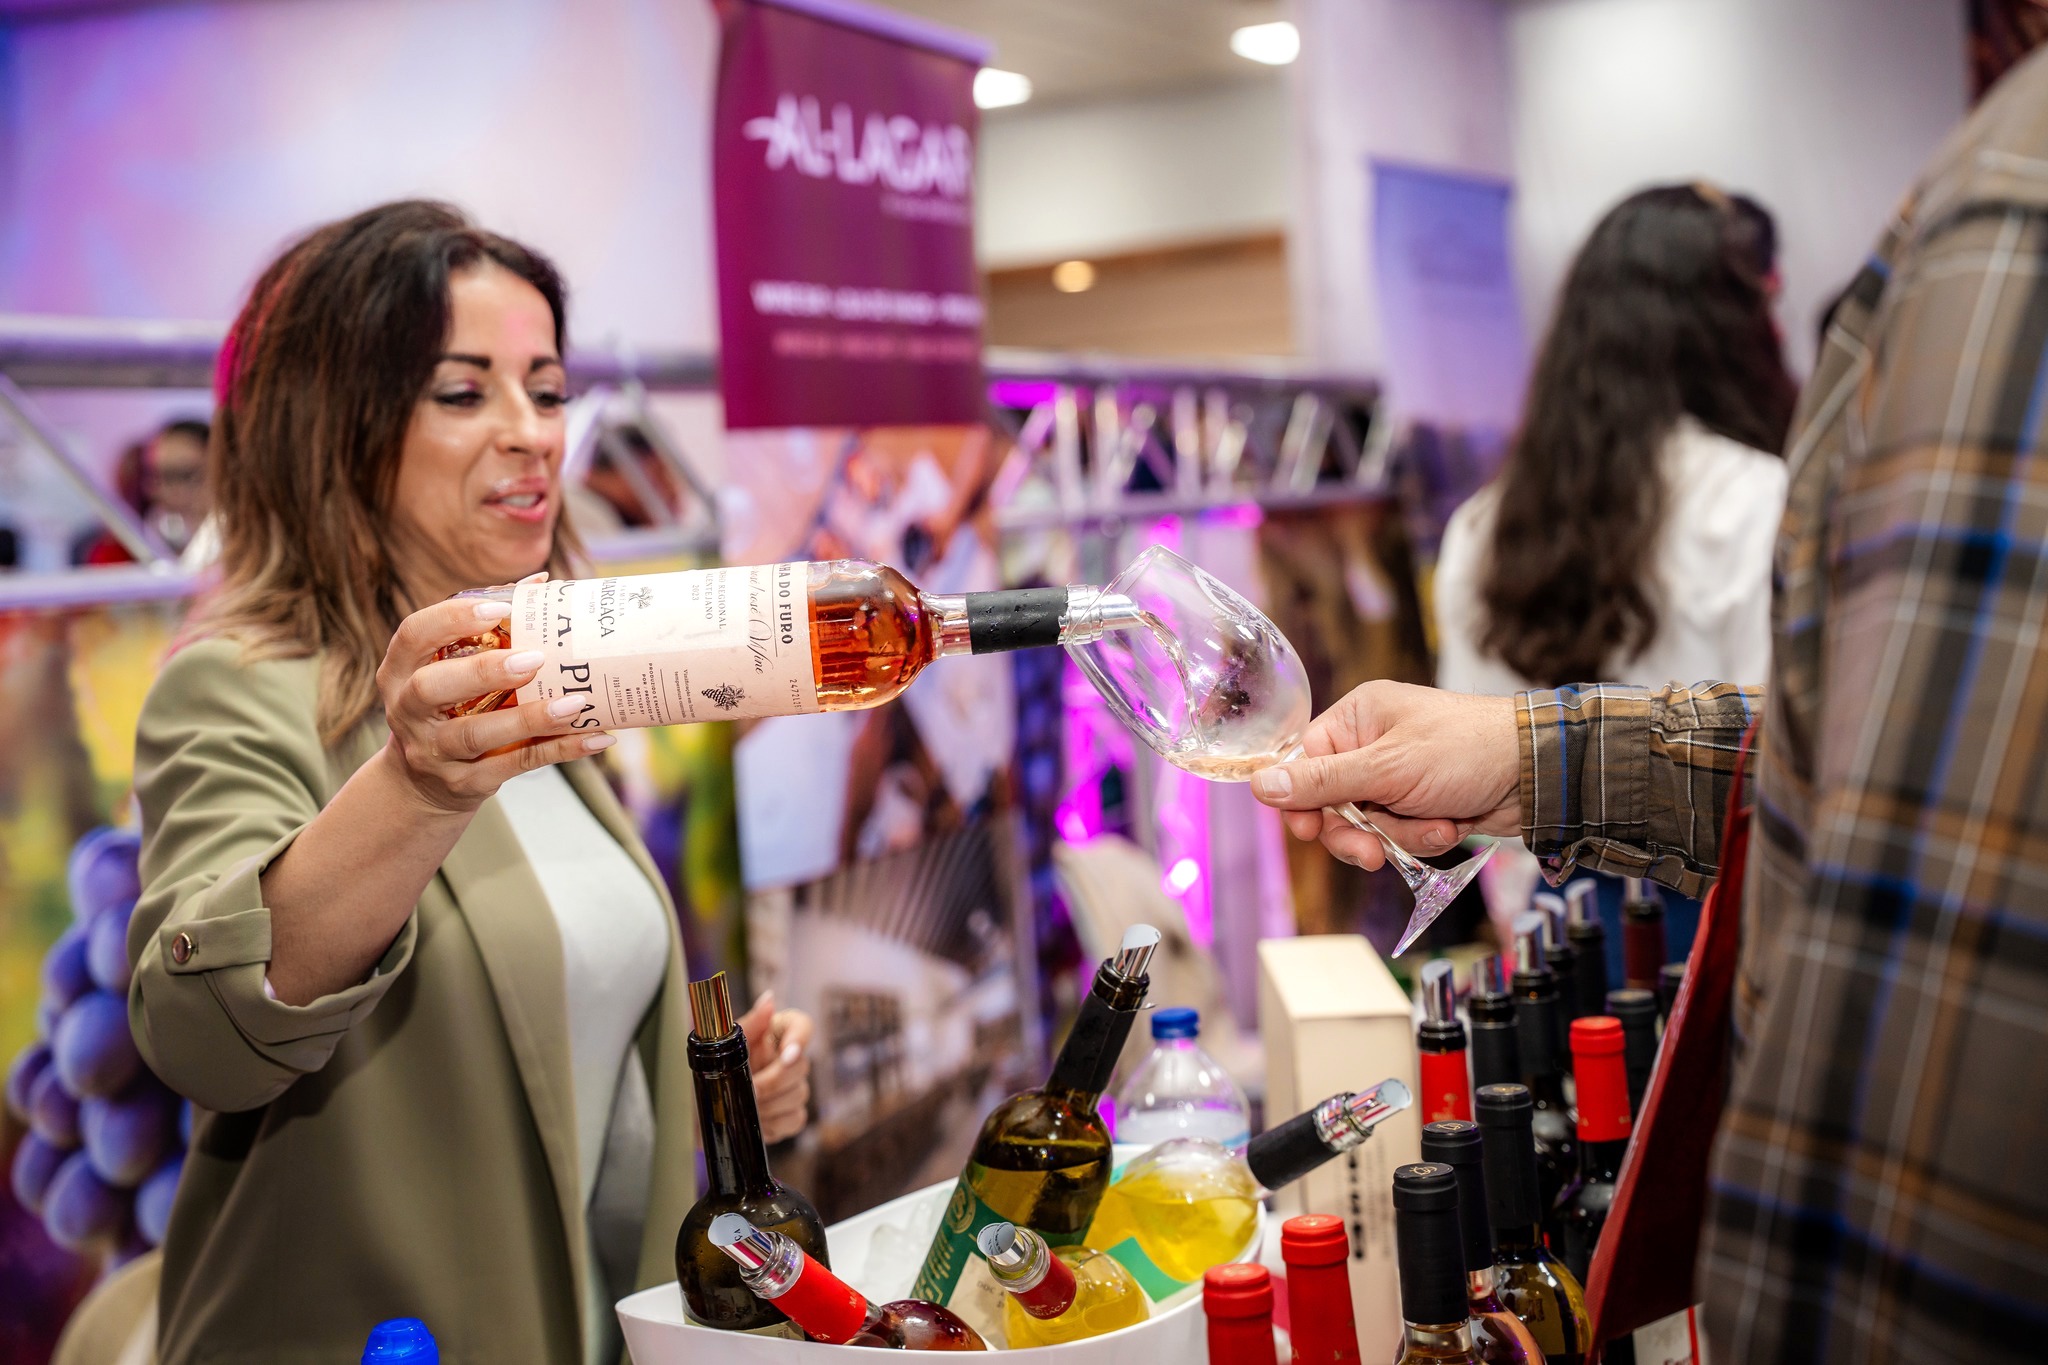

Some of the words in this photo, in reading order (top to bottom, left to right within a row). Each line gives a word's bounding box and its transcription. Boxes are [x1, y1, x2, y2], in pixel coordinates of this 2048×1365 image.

[718, 584, 727, 630] REGIONAL
[779, 581, 791, 598] DO
[779, 604, 793, 645] FURO
